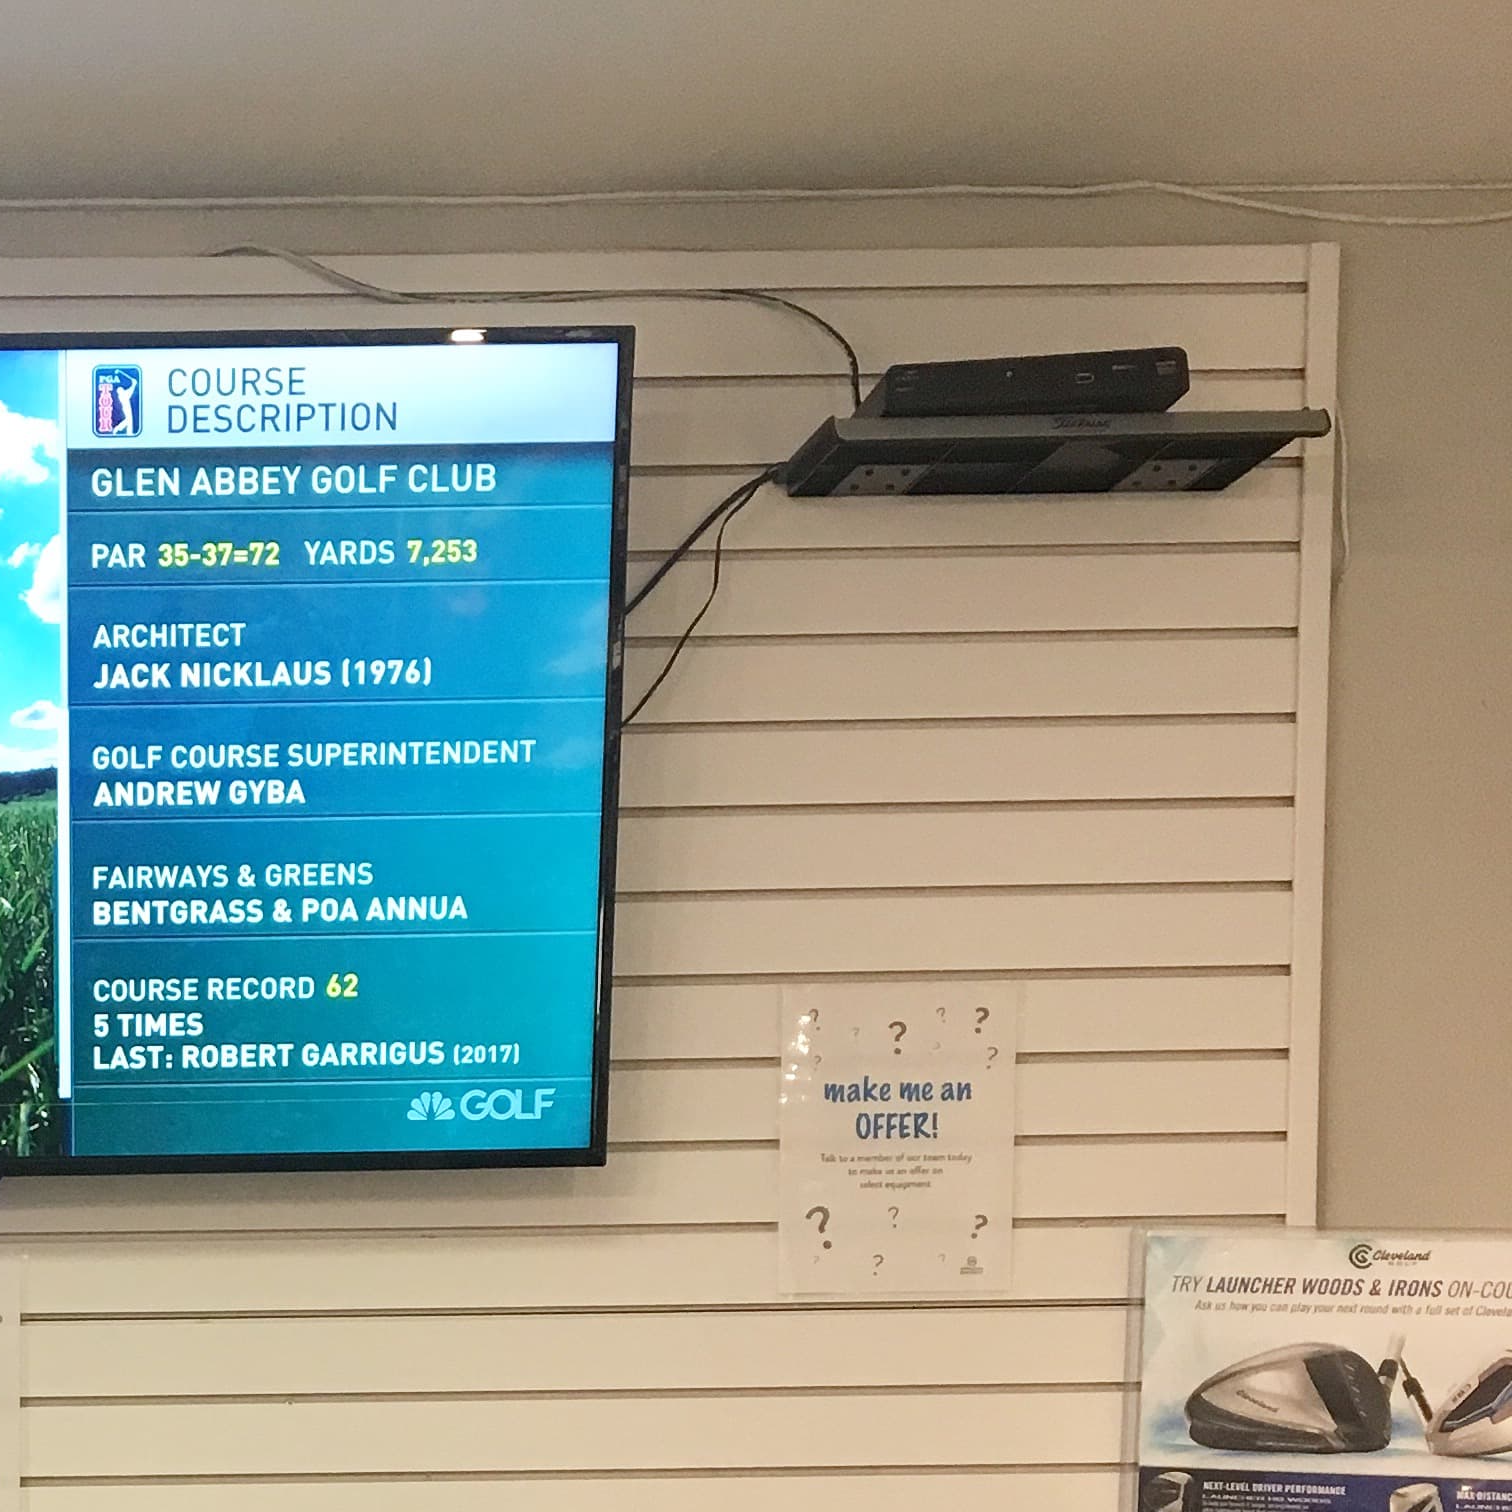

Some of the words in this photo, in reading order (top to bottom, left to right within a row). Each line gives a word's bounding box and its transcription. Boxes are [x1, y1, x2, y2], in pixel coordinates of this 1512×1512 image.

[99, 375, 120, 383] PGA
[168, 367, 306, 397] COURSE
[168, 402, 397, 434] DESCRIPTION
[91, 469, 180, 496] GLEN
[190, 467, 301, 496] ABBEY
[312, 465, 396, 494] GOLF
[407, 464, 496, 492] CLUB
[91, 545, 145, 568] PAR
[158, 541, 279, 566] 35-37=72
[305, 541, 395, 565] YARDS
[407, 539, 478, 566] 7,253
[93, 623, 246, 648] ARCHITECT
[93, 663, 171, 689] JACK
[180, 661, 331, 687] NICKLAUS
[341, 658, 432, 686] (1976)
[92, 746, 162, 770] GOLF
[171, 744, 280, 769] COURSE
[287, 740, 536, 767] SUPERINTENDENT
[93, 782, 220, 807] ANDREW
[229, 780, 305, 805] GYBA
[93, 865, 228, 889] FAIRWAYS
[238, 864, 255, 887] &
[265, 863, 373, 887] GREENS
[93, 900, 263, 925] BENTGRASS
[272, 900, 292, 923] &
[301, 898, 359, 922] POA
[366, 896, 468, 920] ANNUA
[93, 978, 198, 1002] COURSE
[207, 976, 315, 1000] RECORD
[326, 974, 359, 998] 62
[94, 1013, 109, 1038] 5
[117, 1012, 203, 1037] TIMES
[93, 1045, 173, 1070] LAST:
[182, 1043, 293, 1068] ROBERT
[301, 1041, 444, 1066] GARRIGUS
[453, 1043, 519, 1066] (2017)
[824, 1076, 890, 1102] make
[900, 1082, 933, 1102] me
[941, 1082, 971, 1102] an
[460, 1088, 556, 1120] GOLF
[856, 1112, 938, 1139] OFFER!
[1373, 1250, 1432, 1261] Cleveland
[1171, 1275, 1204, 1293] TRY
[1206, 1276, 1296, 1295] LAUNCHER
[1302, 1278, 1365, 1296] WOODS
[1369, 1279, 1381, 1296] &
[1388, 1279, 1443, 1297] IRONS
[1195, 1300, 1212, 1311] Ask
[1215, 1302, 1225, 1311] us
[1230, 1300, 1248, 1311] how
[1250, 1303, 1267, 1314] you
[1270, 1303, 1287, 1312] can
[1290, 1301, 1311, 1314] play
[1313, 1304, 1334, 1314] your
[1337, 1304, 1357, 1313] next
[1360, 1304, 1388, 1314] round
[1391, 1304, 1412, 1314] with
[1425, 1305, 1442, 1315] full
[1445, 1306, 1460, 1316] set
[1464, 1305, 1473, 1316] of
[1203, 1481, 1250, 1492] NEXT-LEVEL
[1252, 1483, 1283, 1493] DRIVER
[1285, 1484, 1346, 1496] PERFORMANCE
[1457, 1491, 1475, 1500] MAX
